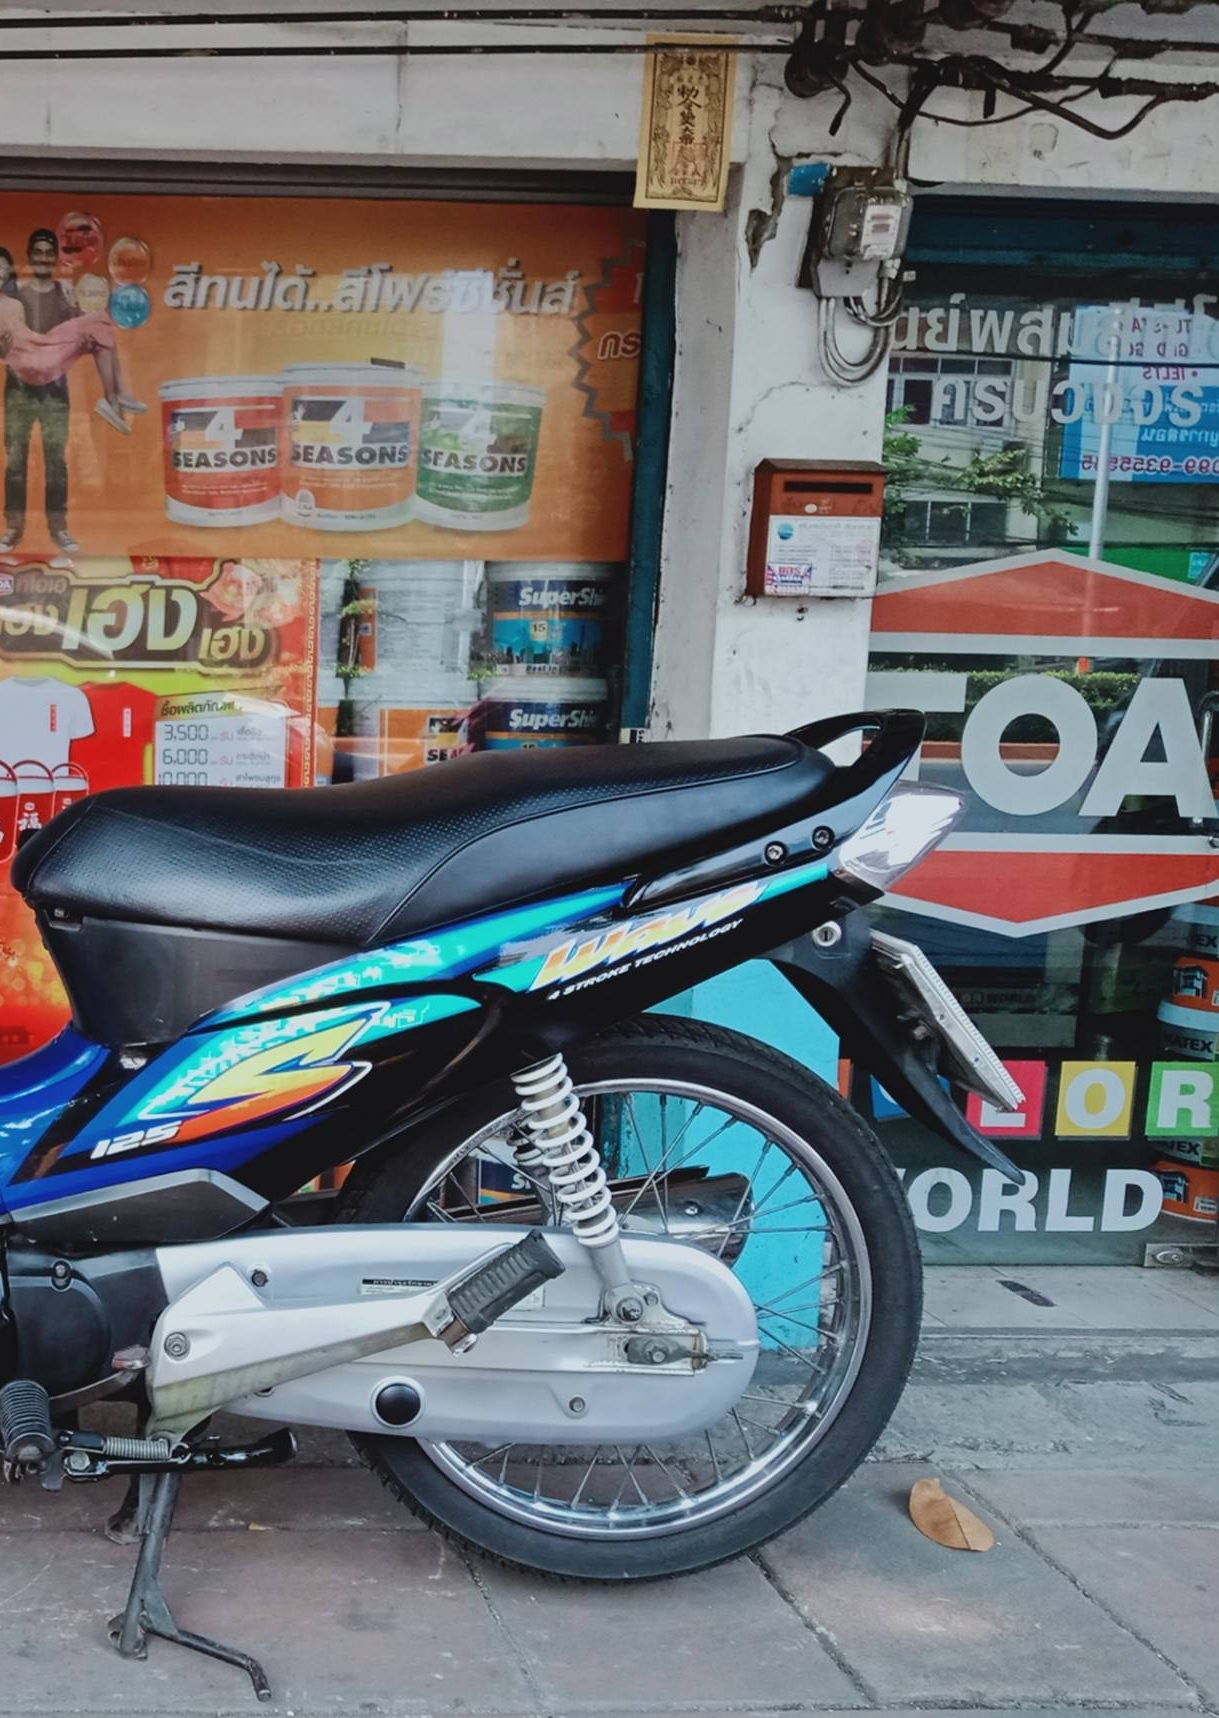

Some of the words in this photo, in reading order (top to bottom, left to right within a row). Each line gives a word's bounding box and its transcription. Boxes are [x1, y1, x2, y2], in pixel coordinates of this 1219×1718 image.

[173, 449, 277, 469] SEASONS
[291, 444, 408, 467] SEASONS
[863, 672, 1219, 817] TOA
[563, 962, 632, 997] STROKE
[634, 917, 744, 969] TECHNOLOGY
[90, 1121, 184, 1160] 125
[897, 1167, 1164, 1233] ORLD
